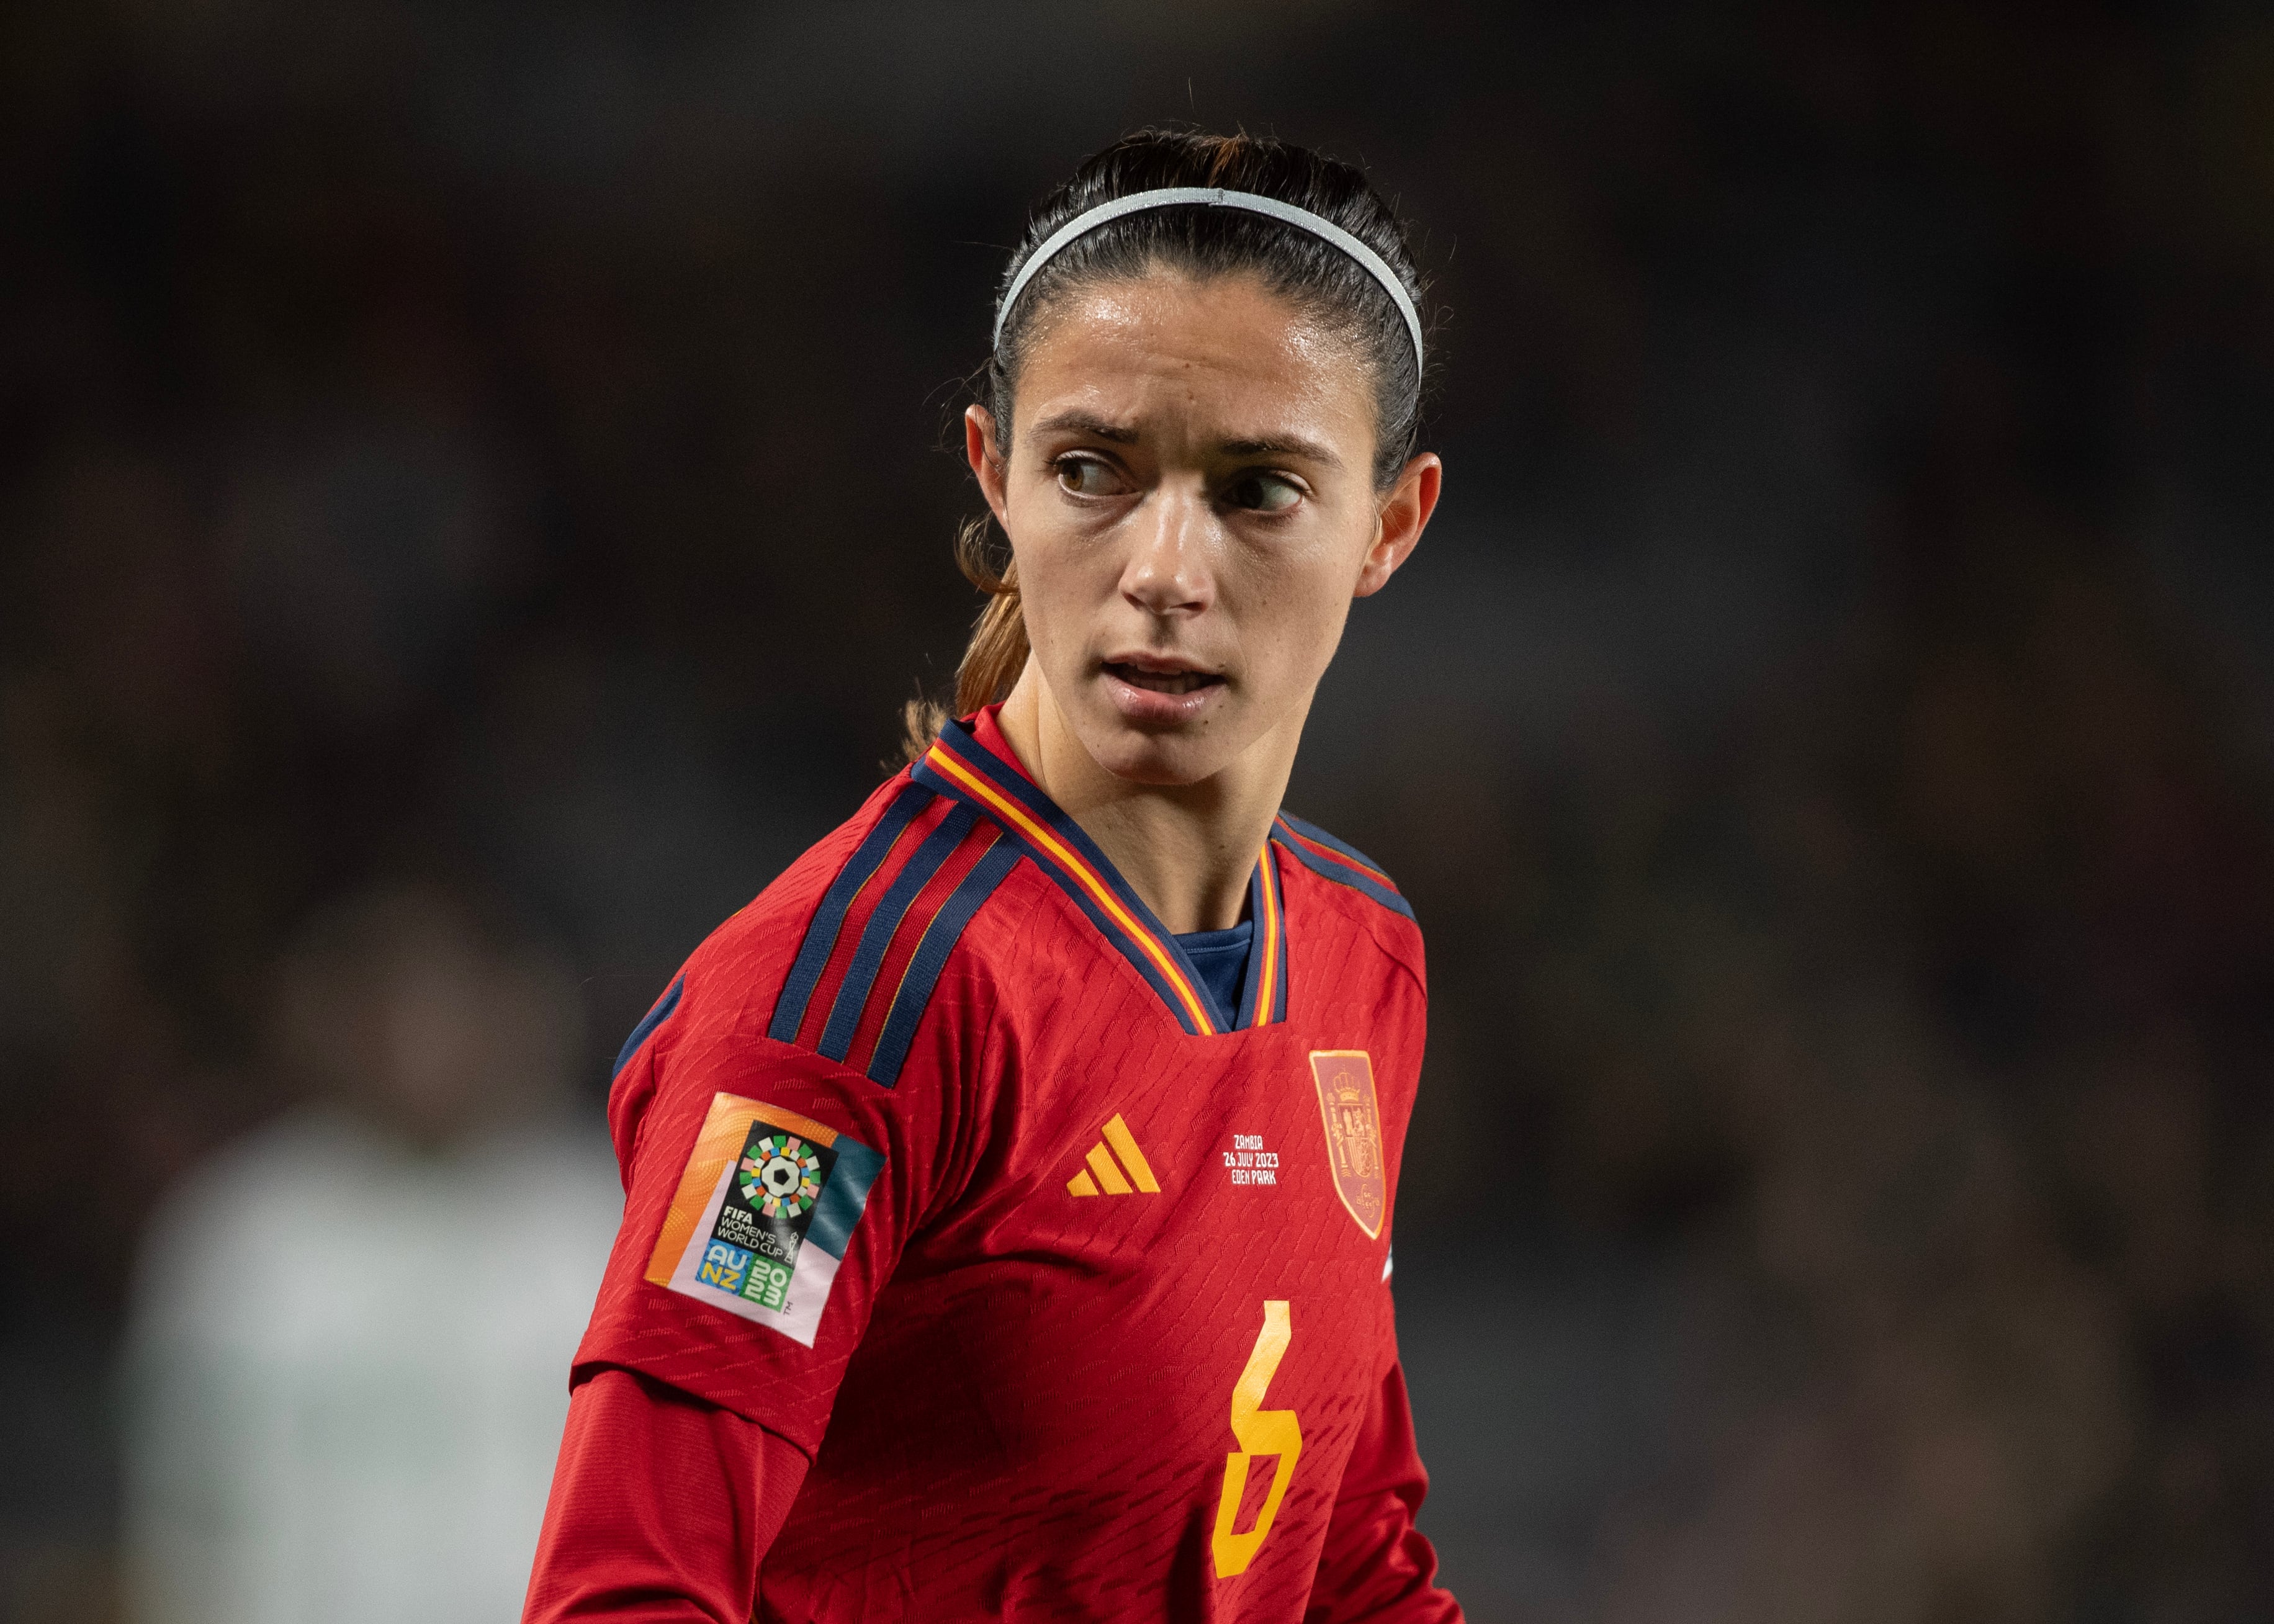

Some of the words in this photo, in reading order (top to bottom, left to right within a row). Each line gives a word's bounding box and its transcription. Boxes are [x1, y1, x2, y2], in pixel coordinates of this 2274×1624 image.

[1234, 1134, 1263, 1150] ZAMBIA
[1223, 1152, 1236, 1167] 26
[1238, 1152, 1254, 1167] JULY
[1255, 1152, 1279, 1168] 2023
[1231, 1169, 1250, 1184] EDEN
[1251, 1170, 1277, 1185] PARK
[723, 1205, 753, 1224] FIFA
[717, 1226, 760, 1249] WORLD
[760, 1240, 784, 1258] CUP
[722, 1217, 776, 1242] WOMEN'S
[708, 1245, 747, 1270] AU
[701, 1262, 741, 1290] NZ
[750, 1260, 788, 1286] 20
[745, 1278, 782, 1306] 23
[1212, 1300, 1302, 1578] 6
